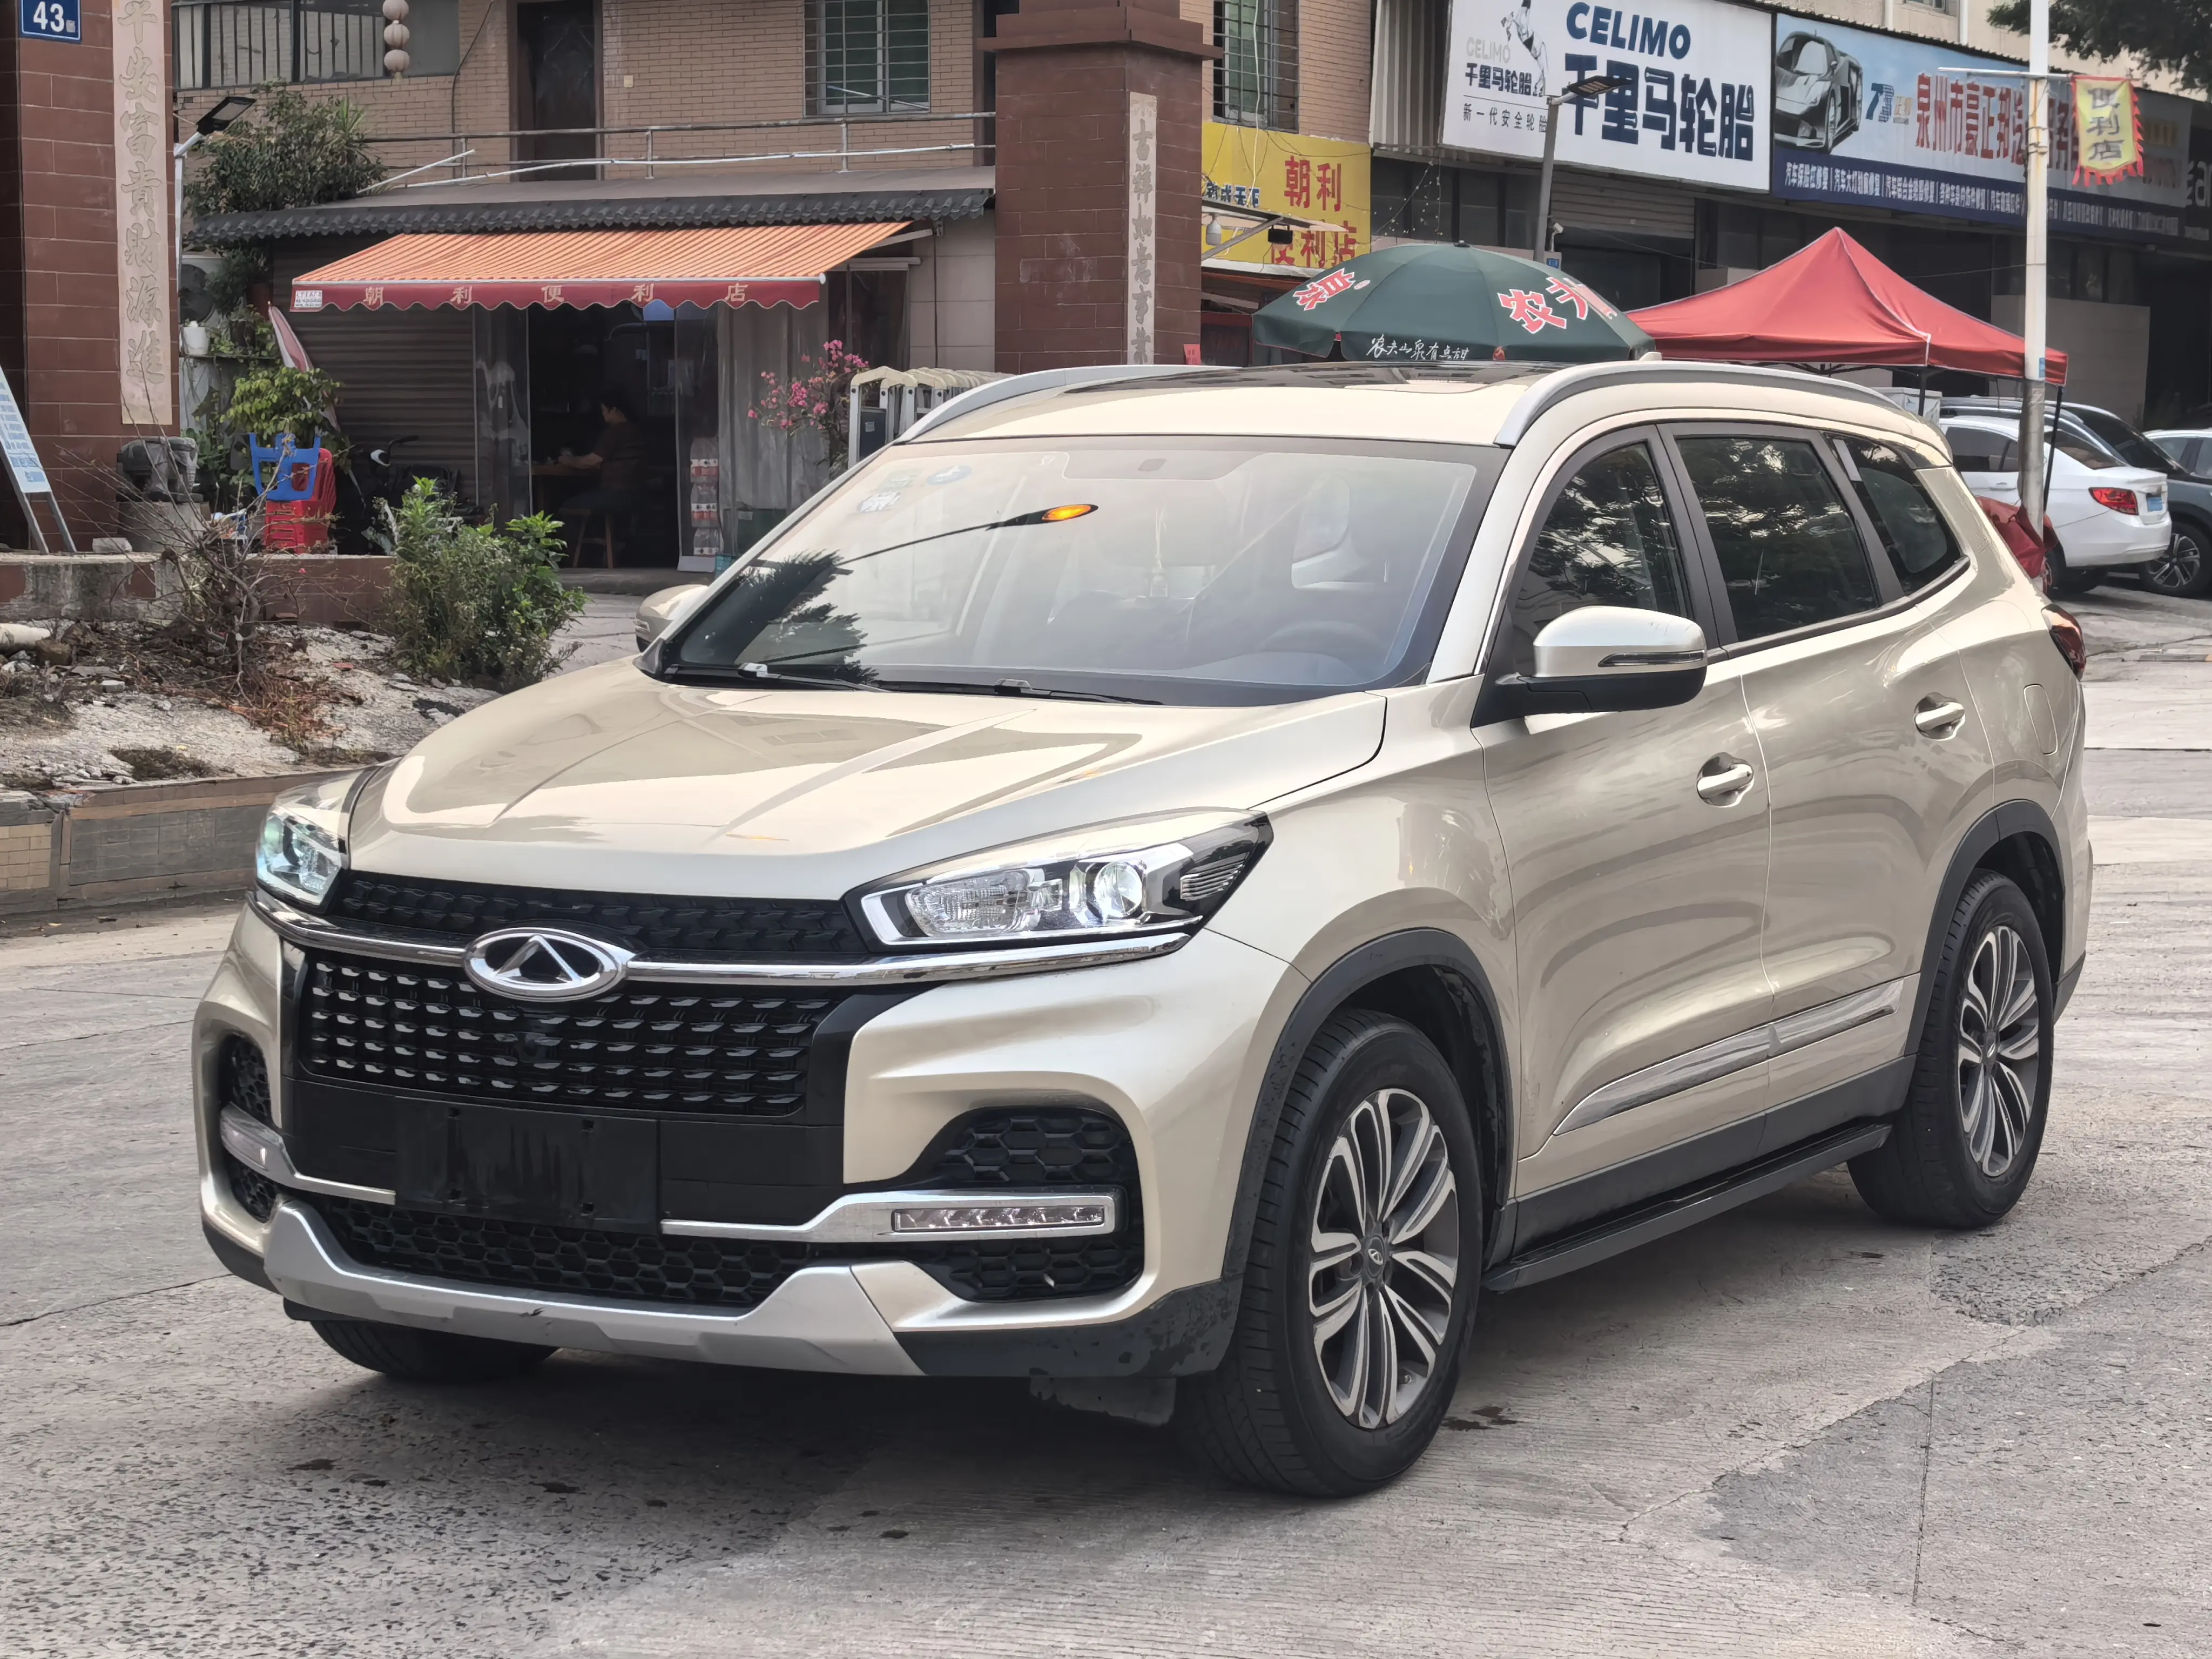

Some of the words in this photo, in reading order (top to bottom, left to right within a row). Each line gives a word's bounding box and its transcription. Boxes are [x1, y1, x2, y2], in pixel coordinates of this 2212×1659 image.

[1567, 2, 1691, 59] CELIMO
[1466, 37, 1510, 64] CELIMO
[1465, 63, 1532, 96] 千里马轮胎
[1463, 103, 1547, 132] 新一代安全轮胎
[1562, 53, 1755, 161] 千里马轮胎
[1284, 156, 1341, 212] 朝利
[1366, 334, 1469, 361] 农夫山泉有点甜
